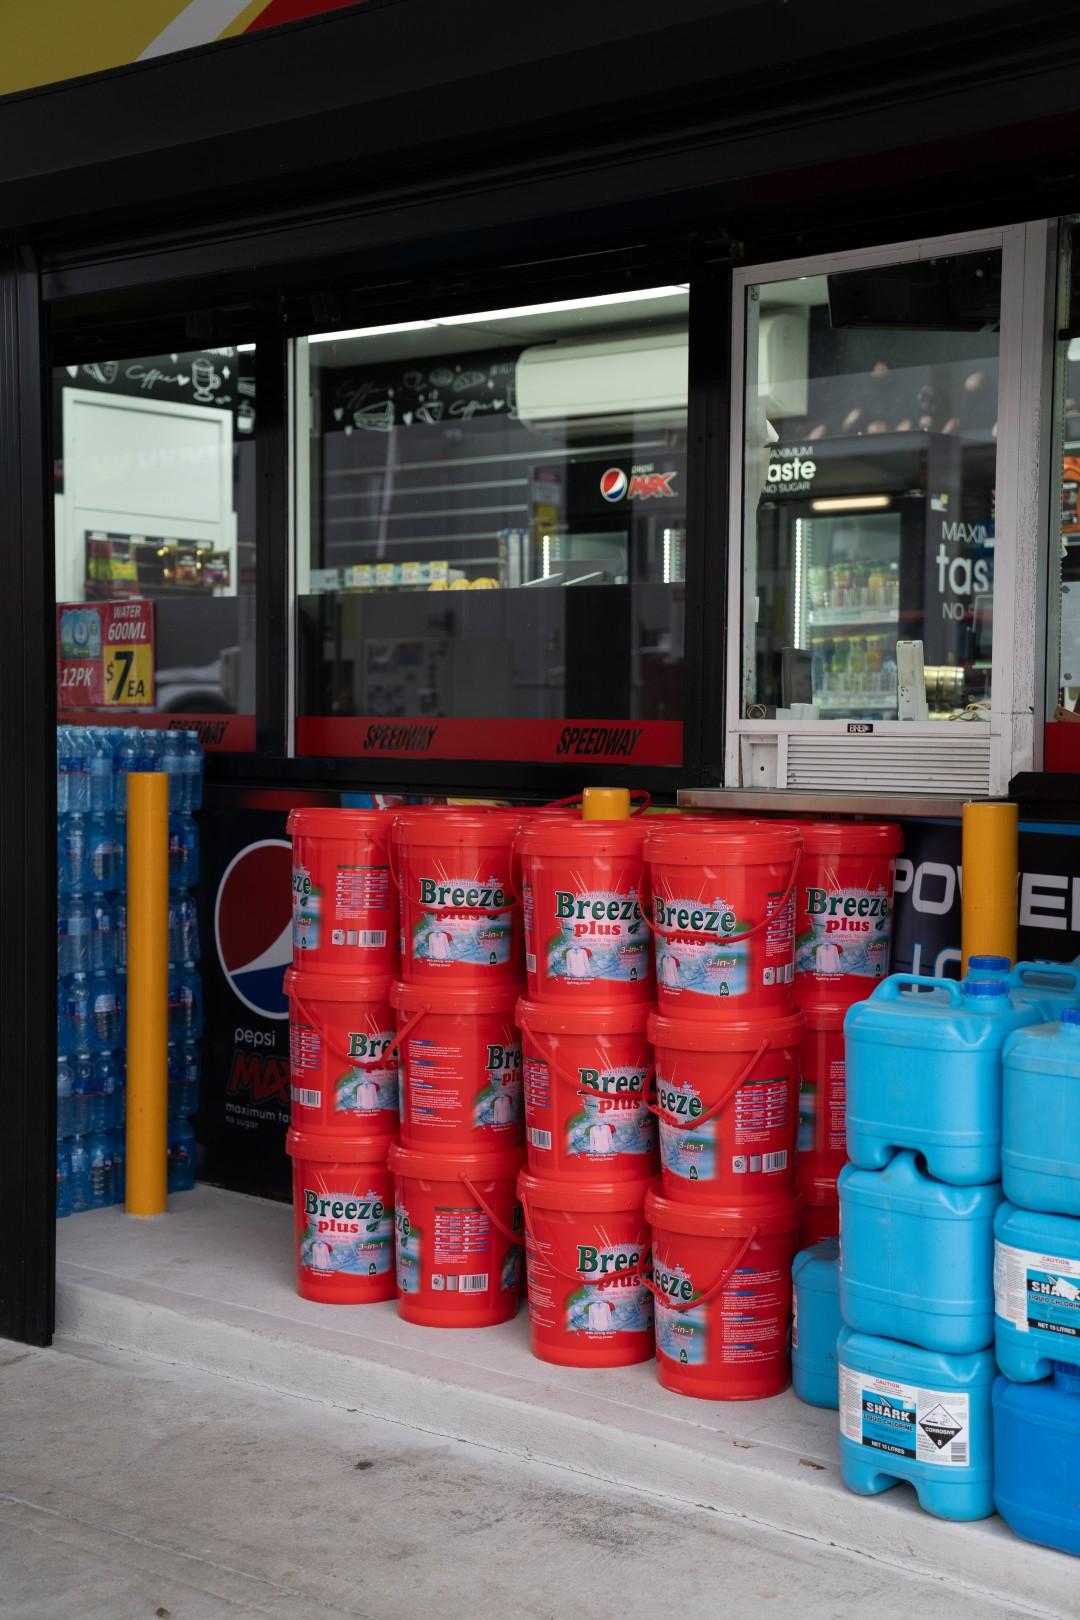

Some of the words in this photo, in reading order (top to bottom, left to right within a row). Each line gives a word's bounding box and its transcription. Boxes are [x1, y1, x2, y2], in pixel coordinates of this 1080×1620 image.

[769, 445, 814, 459] AXIMUM
[767, 457, 816, 483] aste
[936, 543, 989, 595] tas
[113, 605, 141, 618] WATER
[942, 602, 964, 620] NO
[108, 621, 147, 641] 600ML
[61, 667, 93, 687] 12PK
[128, 680, 145, 697] EA
[362, 724, 438, 751] SPEEDWAY
[556, 727, 643, 756] SPEEDWAY
[419, 878, 504, 908] Breeze
[805, 888, 888, 917] Breeze
[555, 891, 643, 921] Breeze
[654, 896, 736, 932] Breeze
[574, 921, 621, 938] plus
[825, 917, 870, 933] plus
[706, 958, 737, 969] 3-in-1
[234, 1028, 276, 1048] pepsi
[347, 1032, 395, 1058] Bre
[577, 1068, 646, 1095] Bree
[225, 1103, 275, 1121] maximum
[278, 1111, 290, 1124] ta
[598, 1099, 640, 1113] plus
[678, 1142, 704, 1152] 3-in-1
[304, 1189, 384, 1220] Breeze
[318, 1219, 359, 1234] plus
[576, 1245, 641, 1273] Bree
[655, 1270, 693, 1301] eeze
[1051, 1299, 1080, 1310] CHLORIN
[1037, 1321, 1049, 1330] NET
[875, 1378, 900, 1389] CAUTION
[866, 1402, 911, 1423] SHARK
[883, 1417, 913, 1432] CHLORINE
[924, 1426, 955, 1436] CORROSIVE
[871, 1440, 881, 1448] NET
[888, 1444, 905, 1455] LITRES
